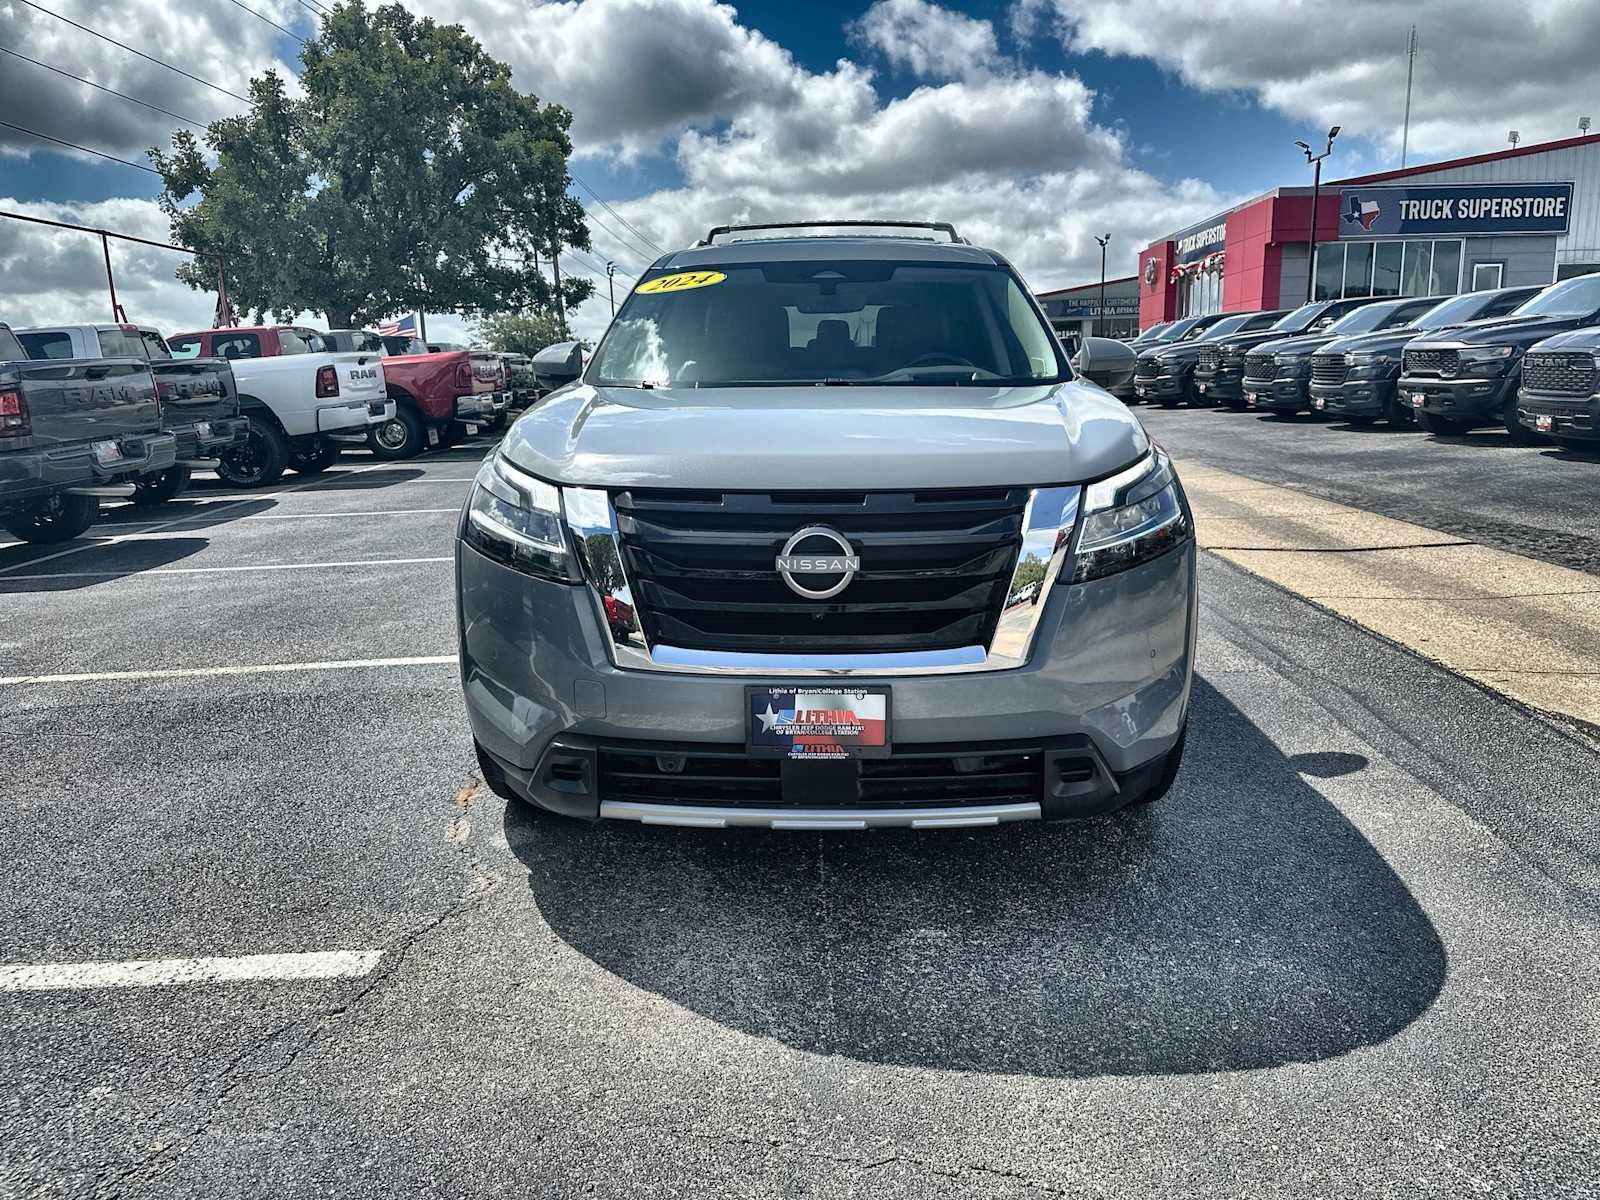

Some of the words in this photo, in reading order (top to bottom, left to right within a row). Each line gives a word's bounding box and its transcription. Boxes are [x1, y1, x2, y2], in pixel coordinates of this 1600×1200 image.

[1400, 199, 1454, 220] TRUCK
[1457, 197, 1565, 219] SUPERSTORE
[1182, 233, 1197, 254] TRUCK
[646, 273, 715, 291] 2024
[1535, 359, 1569, 367] RAM
[350, 369, 377, 380] RAM
[778, 559, 857, 570] NISSAN
[797, 688, 842, 696] Bryan/College
[795, 709, 861, 725] LITHIA
[804, 744, 845, 753] LITHIA
